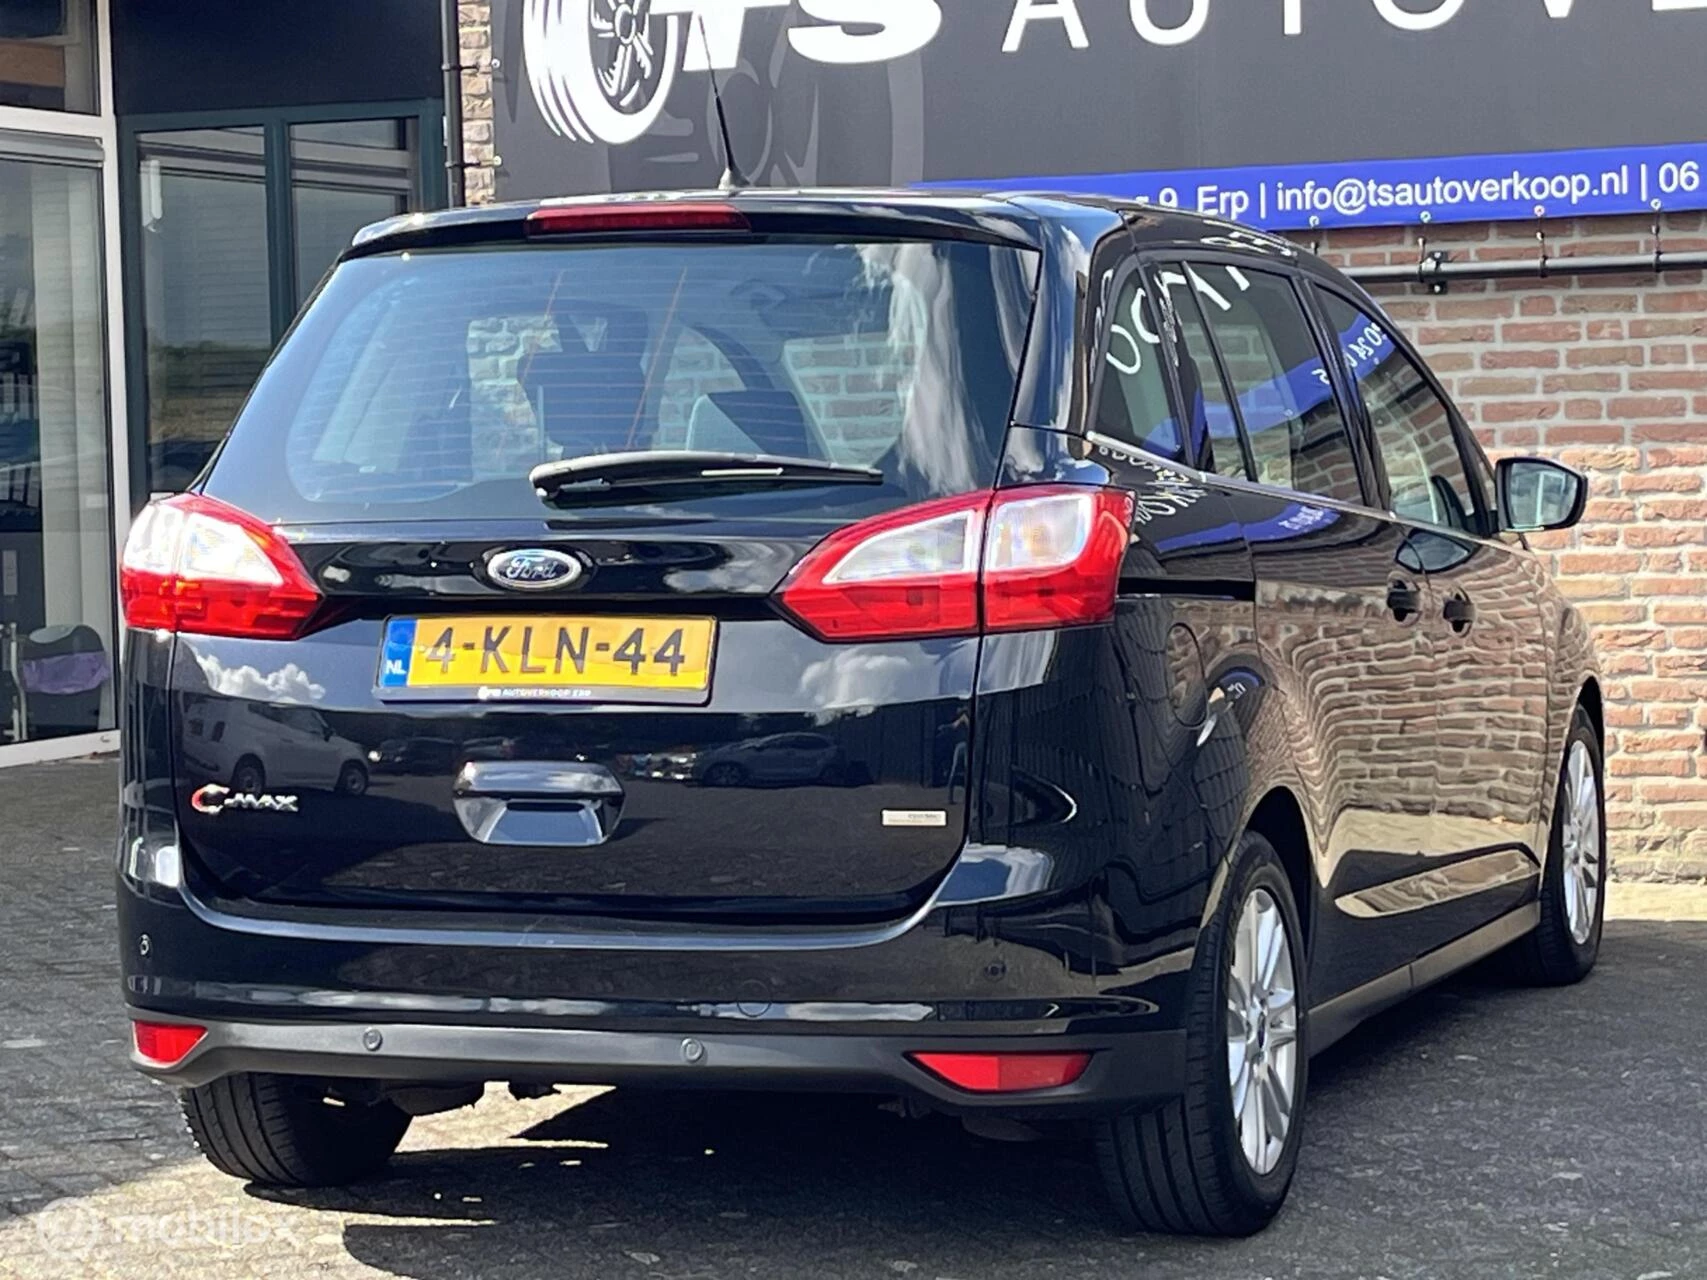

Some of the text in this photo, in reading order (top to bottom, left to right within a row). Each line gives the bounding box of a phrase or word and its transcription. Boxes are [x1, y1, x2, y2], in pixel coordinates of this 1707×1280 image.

[1196, 184, 1250, 221] Erp
[1276, 164, 1629, 216] info@tsautoverkoop.nl
[1658, 160, 1700, 195] 06
[505, 555, 559, 580] Ford
[385, 659, 408, 675] NL
[424, 626, 686, 677] 4-KLN-44
